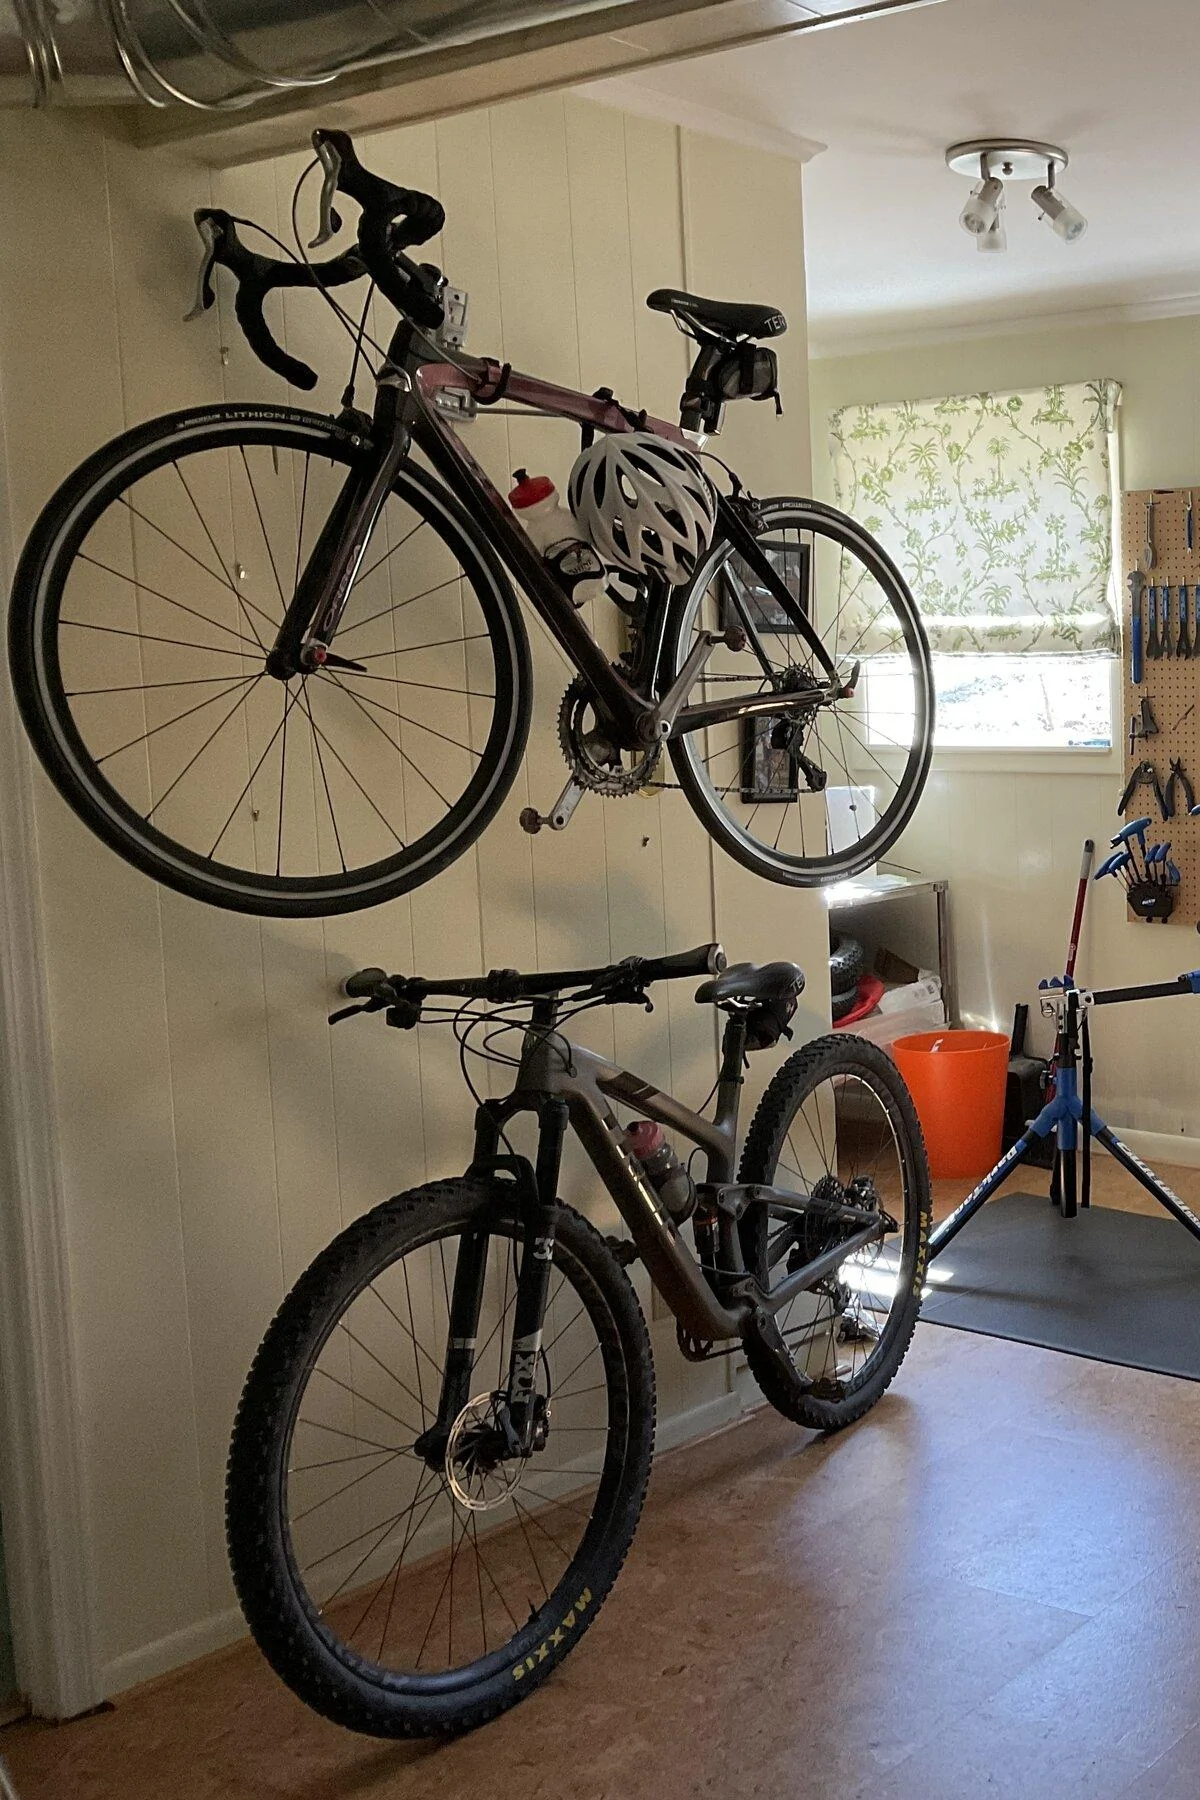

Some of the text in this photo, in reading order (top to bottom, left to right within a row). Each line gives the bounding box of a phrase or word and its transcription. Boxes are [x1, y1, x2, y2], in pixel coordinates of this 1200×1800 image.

[912, 1210, 928, 1299] MAXXIS
[511, 1353, 537, 1403] FOX
[512, 1586, 592, 1681] MAXXIS
